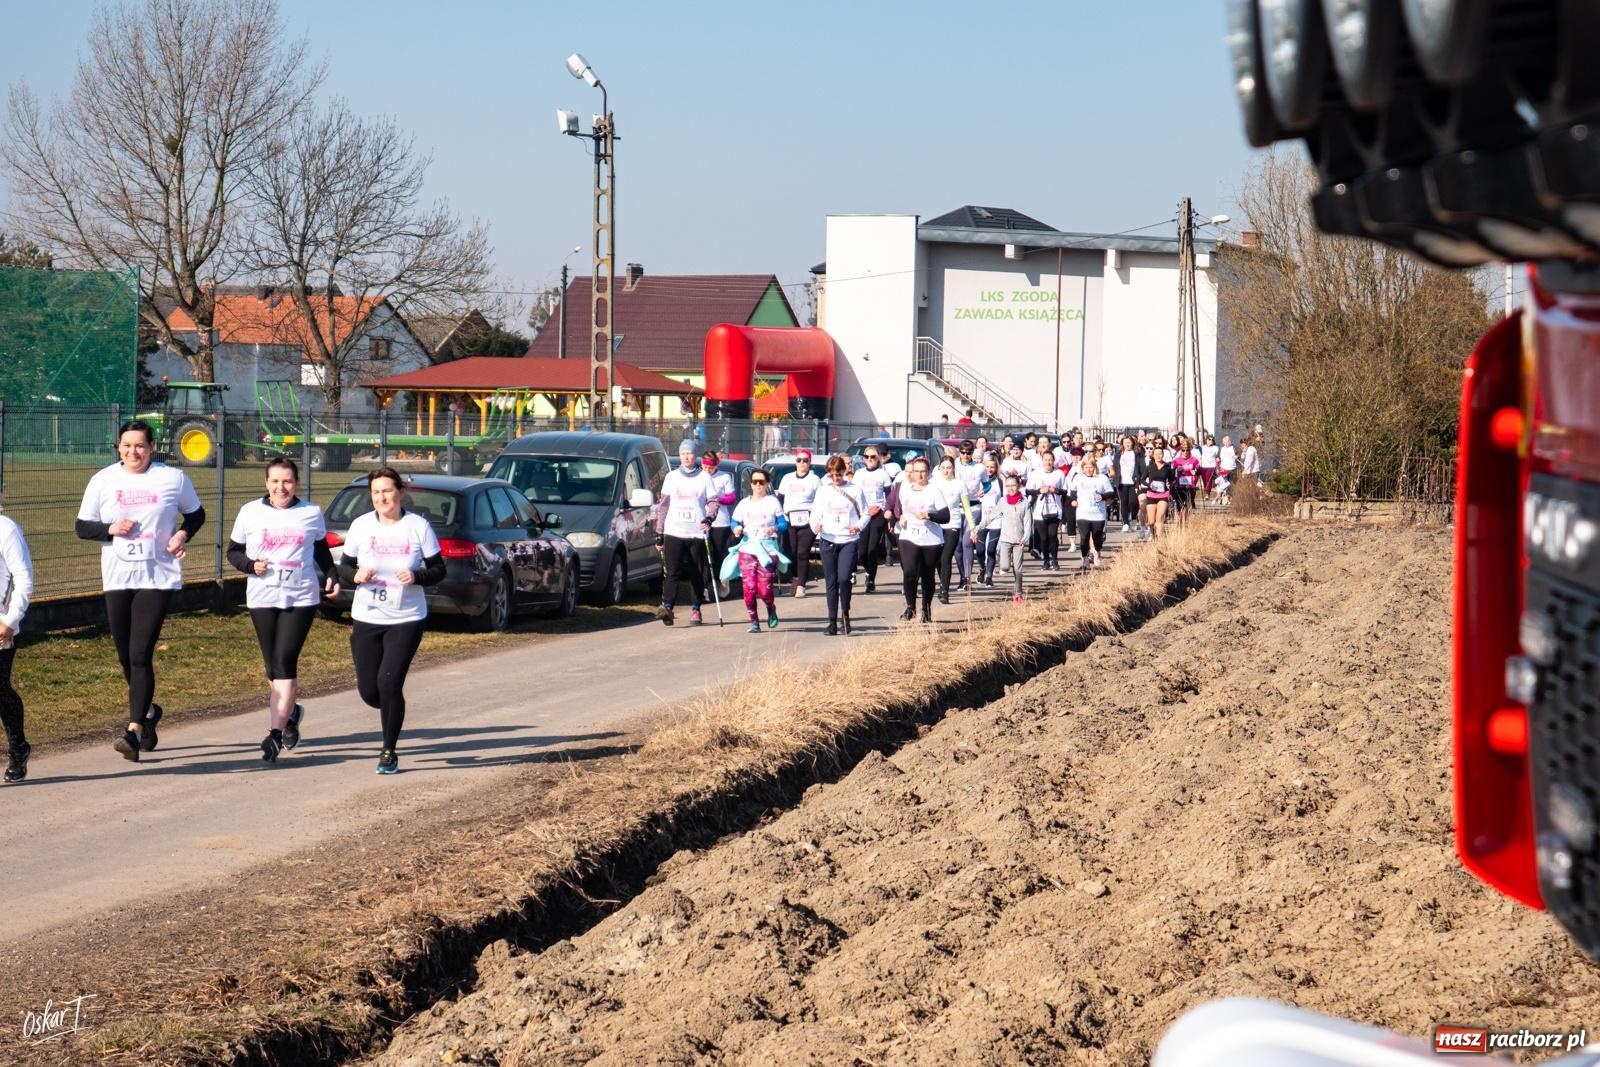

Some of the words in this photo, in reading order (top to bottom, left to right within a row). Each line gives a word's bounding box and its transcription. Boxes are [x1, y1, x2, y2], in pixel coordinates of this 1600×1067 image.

[980, 290, 1004, 302] LKS
[1011, 290, 1059, 302] ZGODA
[954, 308, 1014, 320] ZAWADA
[127, 542, 144, 556] 21
[277, 569, 293, 581] 17
[370, 587, 388, 602] 18
